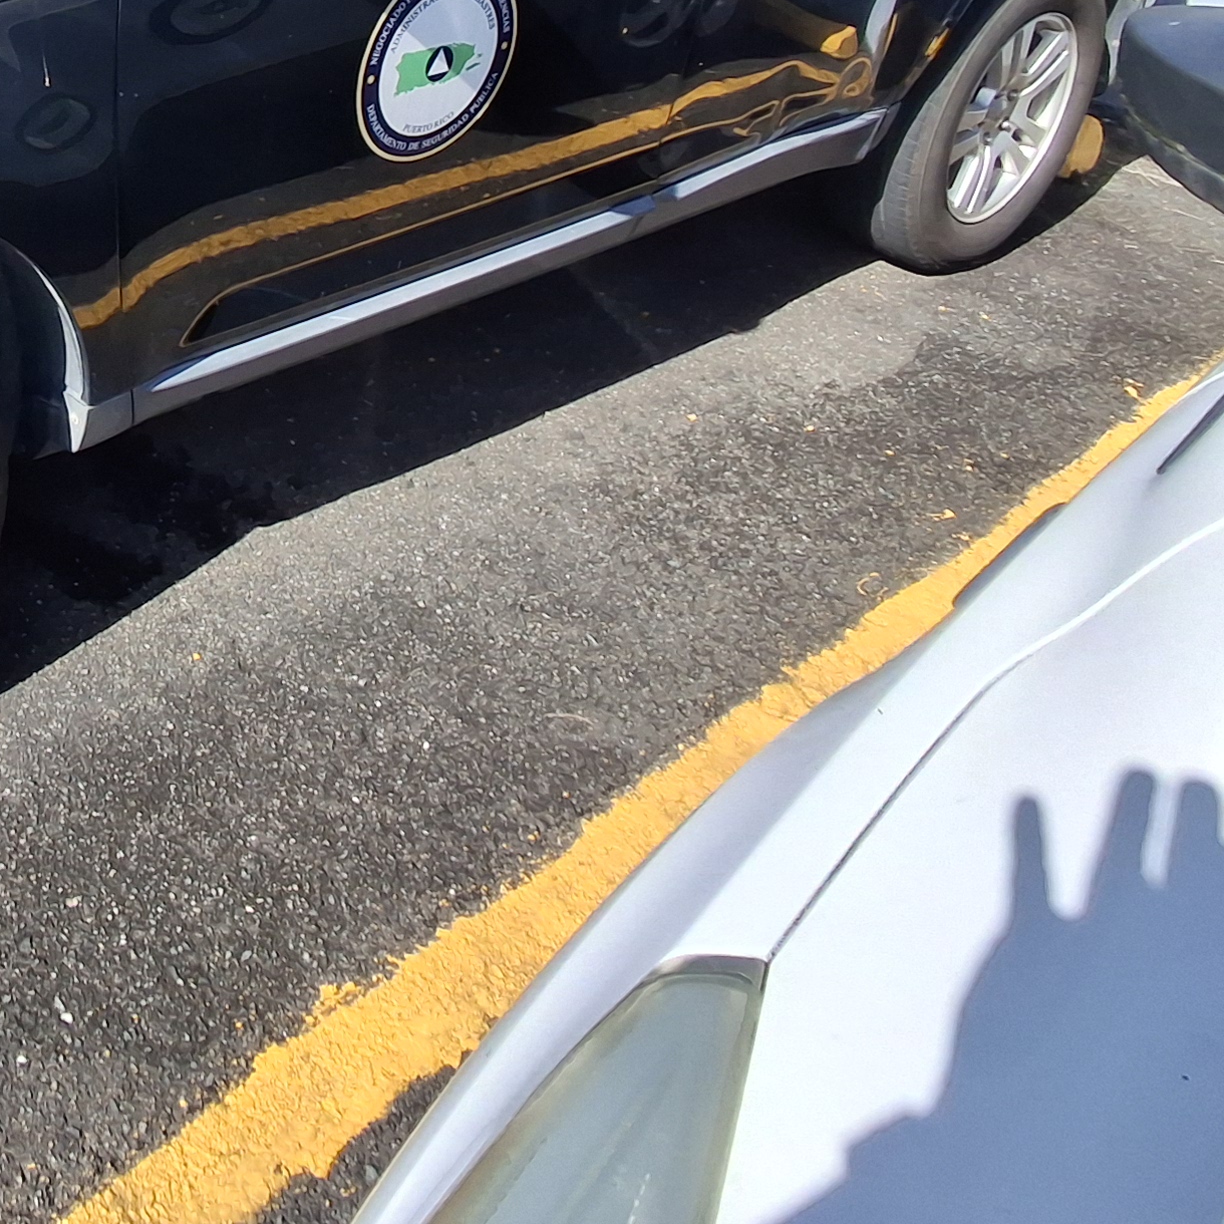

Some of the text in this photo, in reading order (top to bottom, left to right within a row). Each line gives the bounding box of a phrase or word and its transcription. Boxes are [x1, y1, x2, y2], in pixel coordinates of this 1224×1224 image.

[370, 2, 406, 66] NEGOCIADO
[367, 104, 406, 150] DEPARTAMENTO
[408, 140, 419, 151] DE
[421, 113, 469, 149] SEGURIDAD
[402, 111, 455, 133] PUERTO RICO
